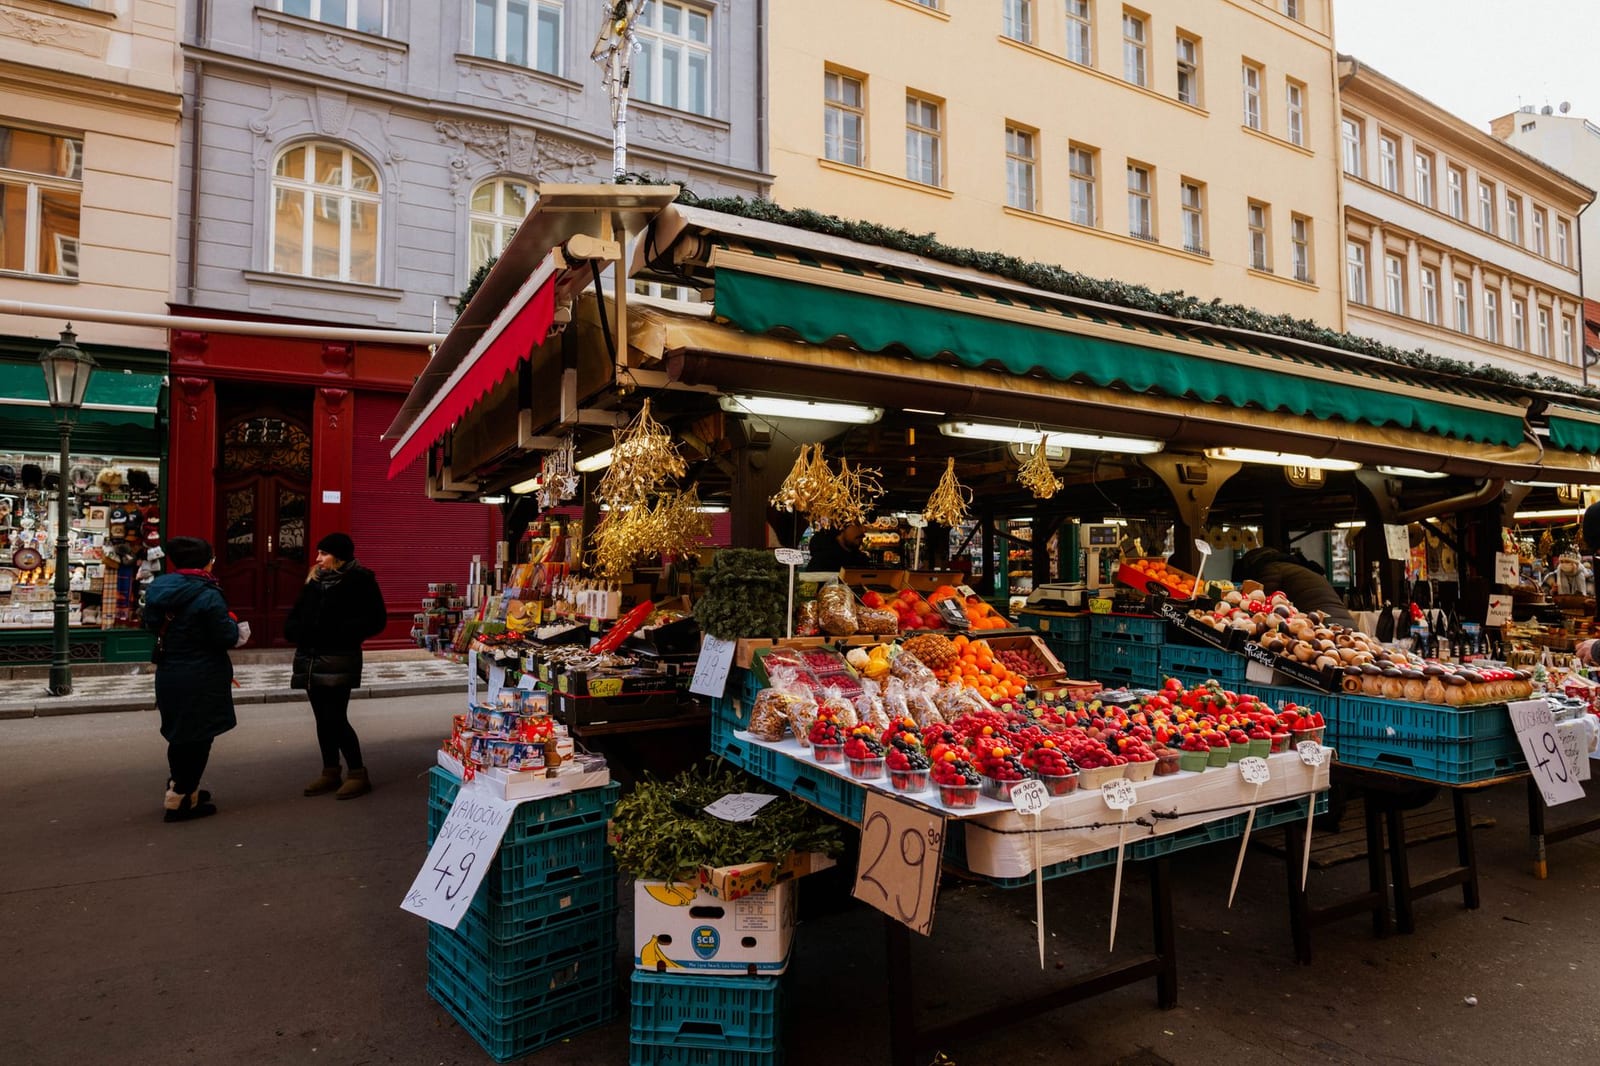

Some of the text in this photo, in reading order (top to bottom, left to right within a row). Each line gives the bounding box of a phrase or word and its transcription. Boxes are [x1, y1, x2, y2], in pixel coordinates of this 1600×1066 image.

[1292, 464, 1306, 479] 19
[1529, 732, 1568, 784] 49
[440, 820, 488, 849] SVÍČKY
[861, 810, 926, 923] 29
[696, 936, 715, 944] SCB
